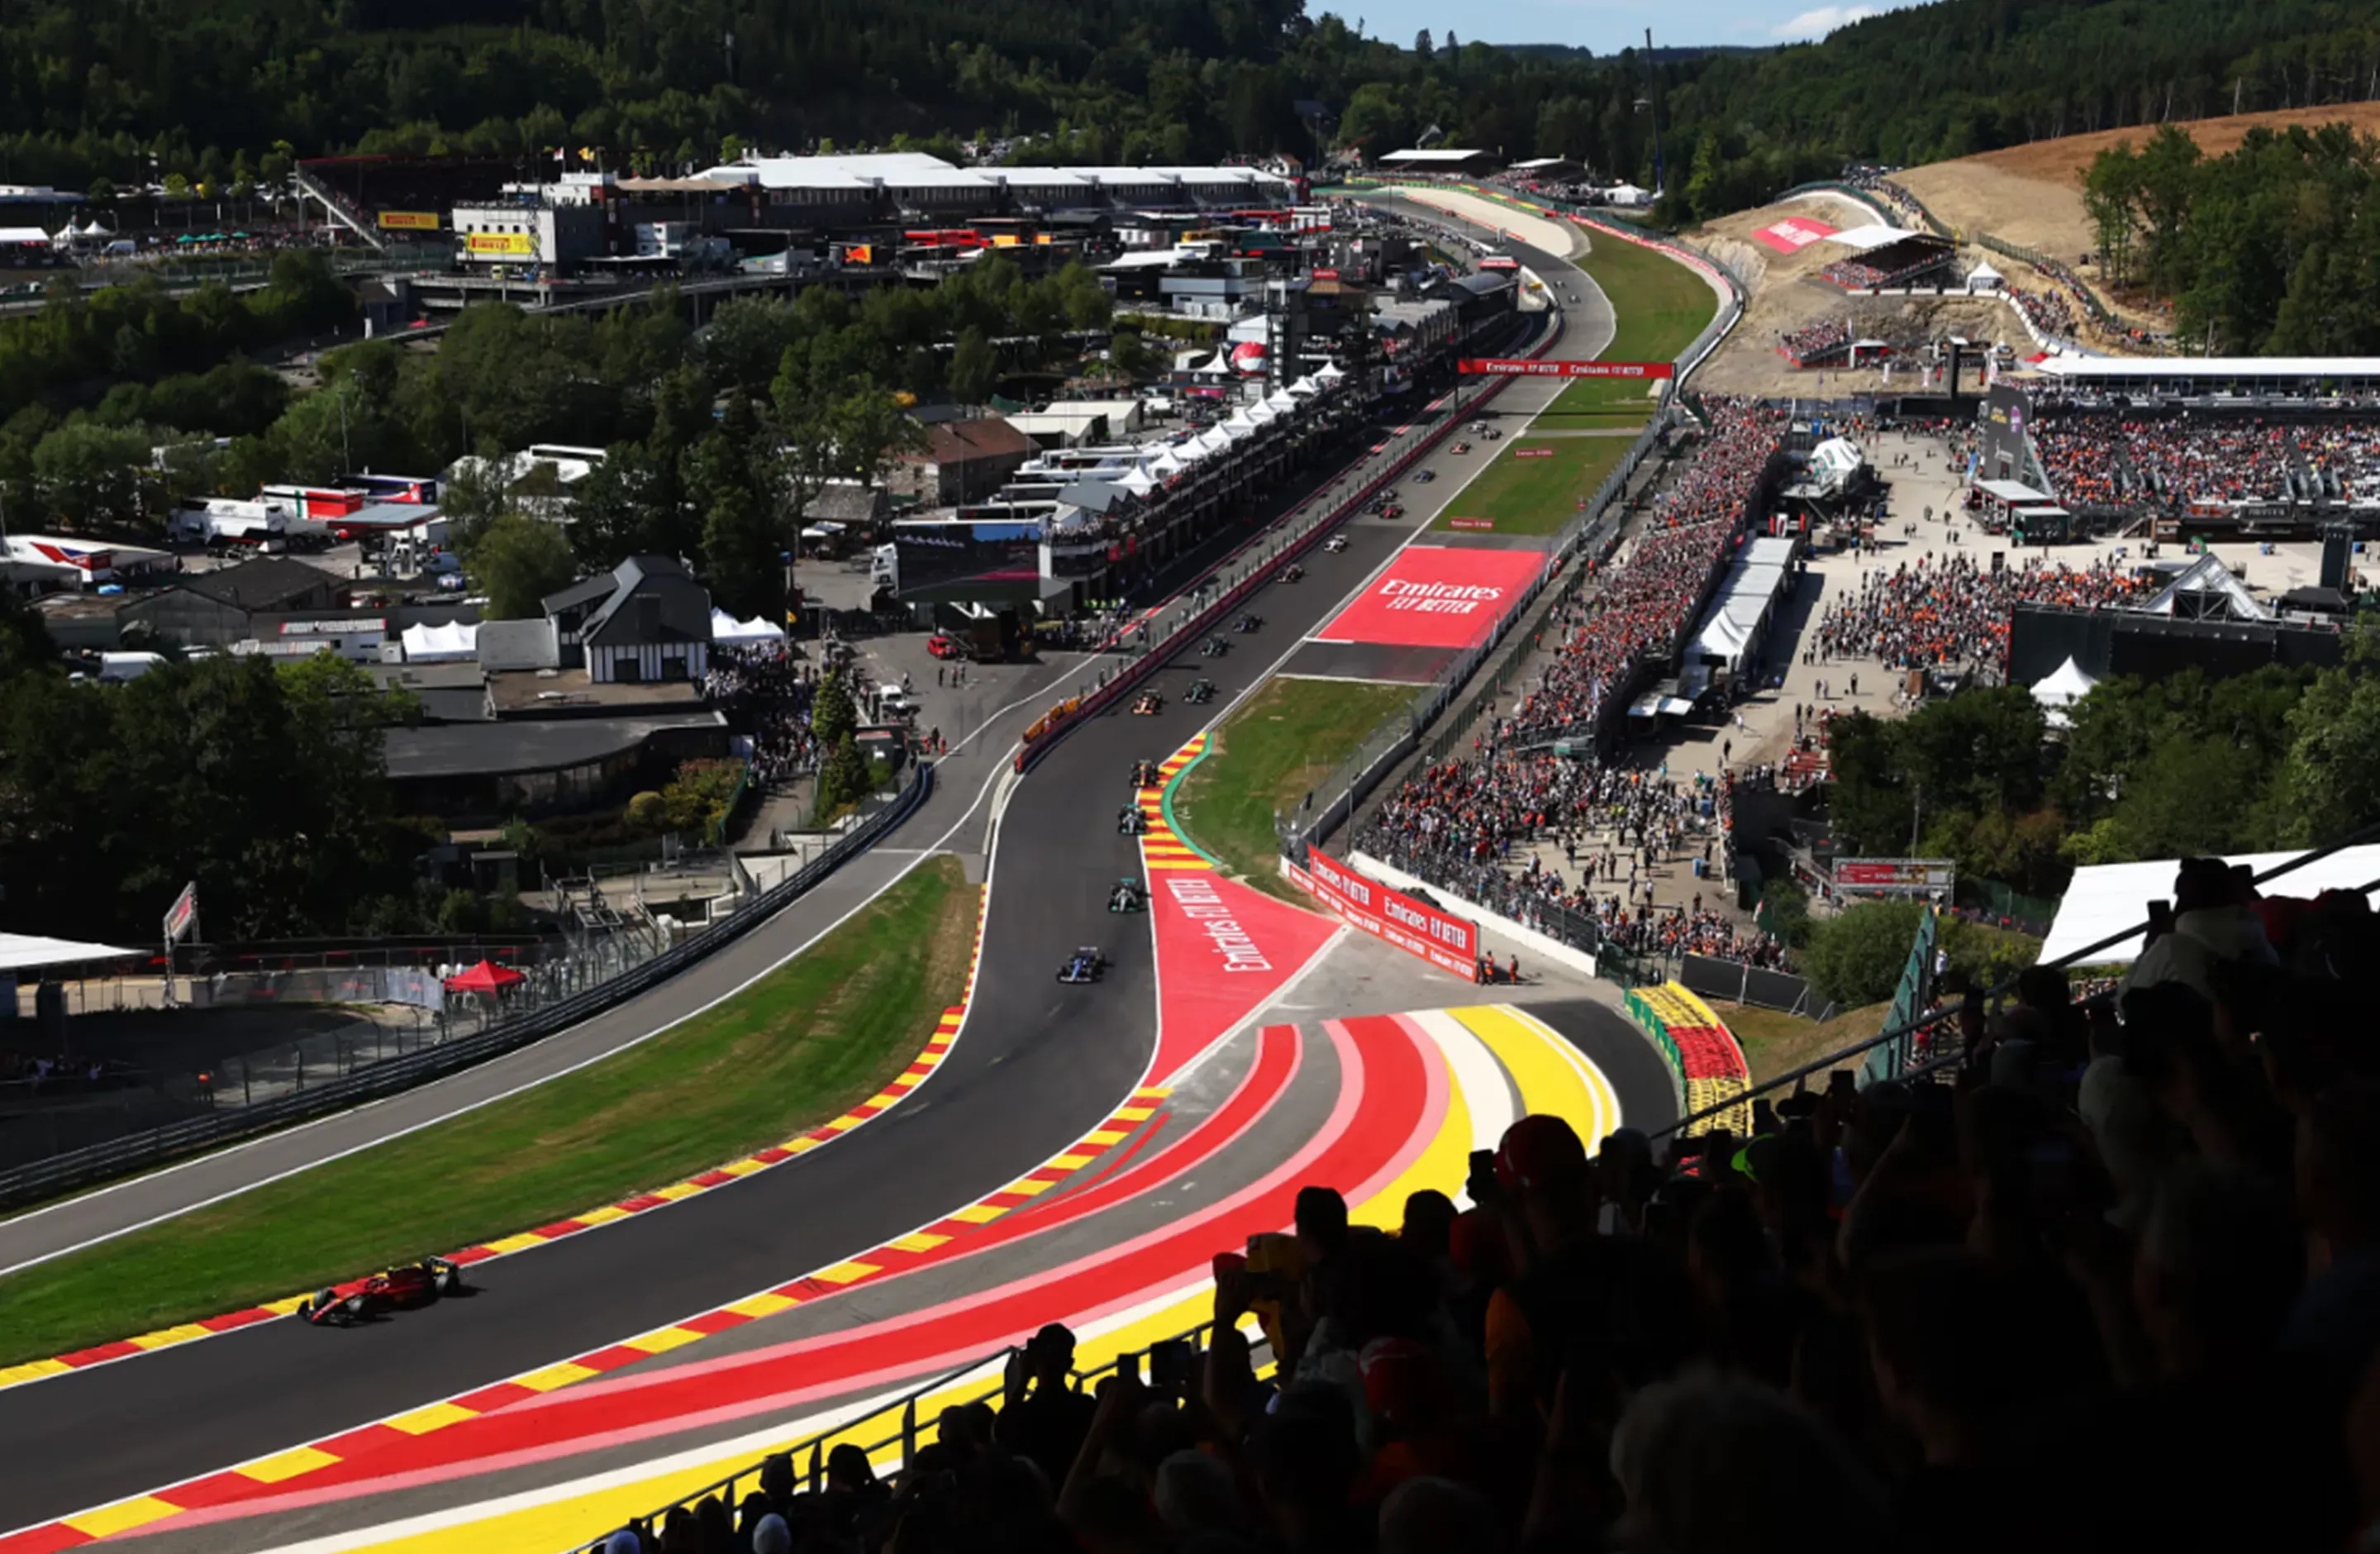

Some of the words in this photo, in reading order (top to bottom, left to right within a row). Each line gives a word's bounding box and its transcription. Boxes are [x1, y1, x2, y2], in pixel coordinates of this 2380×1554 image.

[1378, 579, 1503, 601] Emirates
[1385, 596, 1421, 610] FLY
[1415, 598, 1479, 614] BETTER
[1384, 895, 1427, 932] Emirates
[1202, 919, 1273, 972] Emirates
